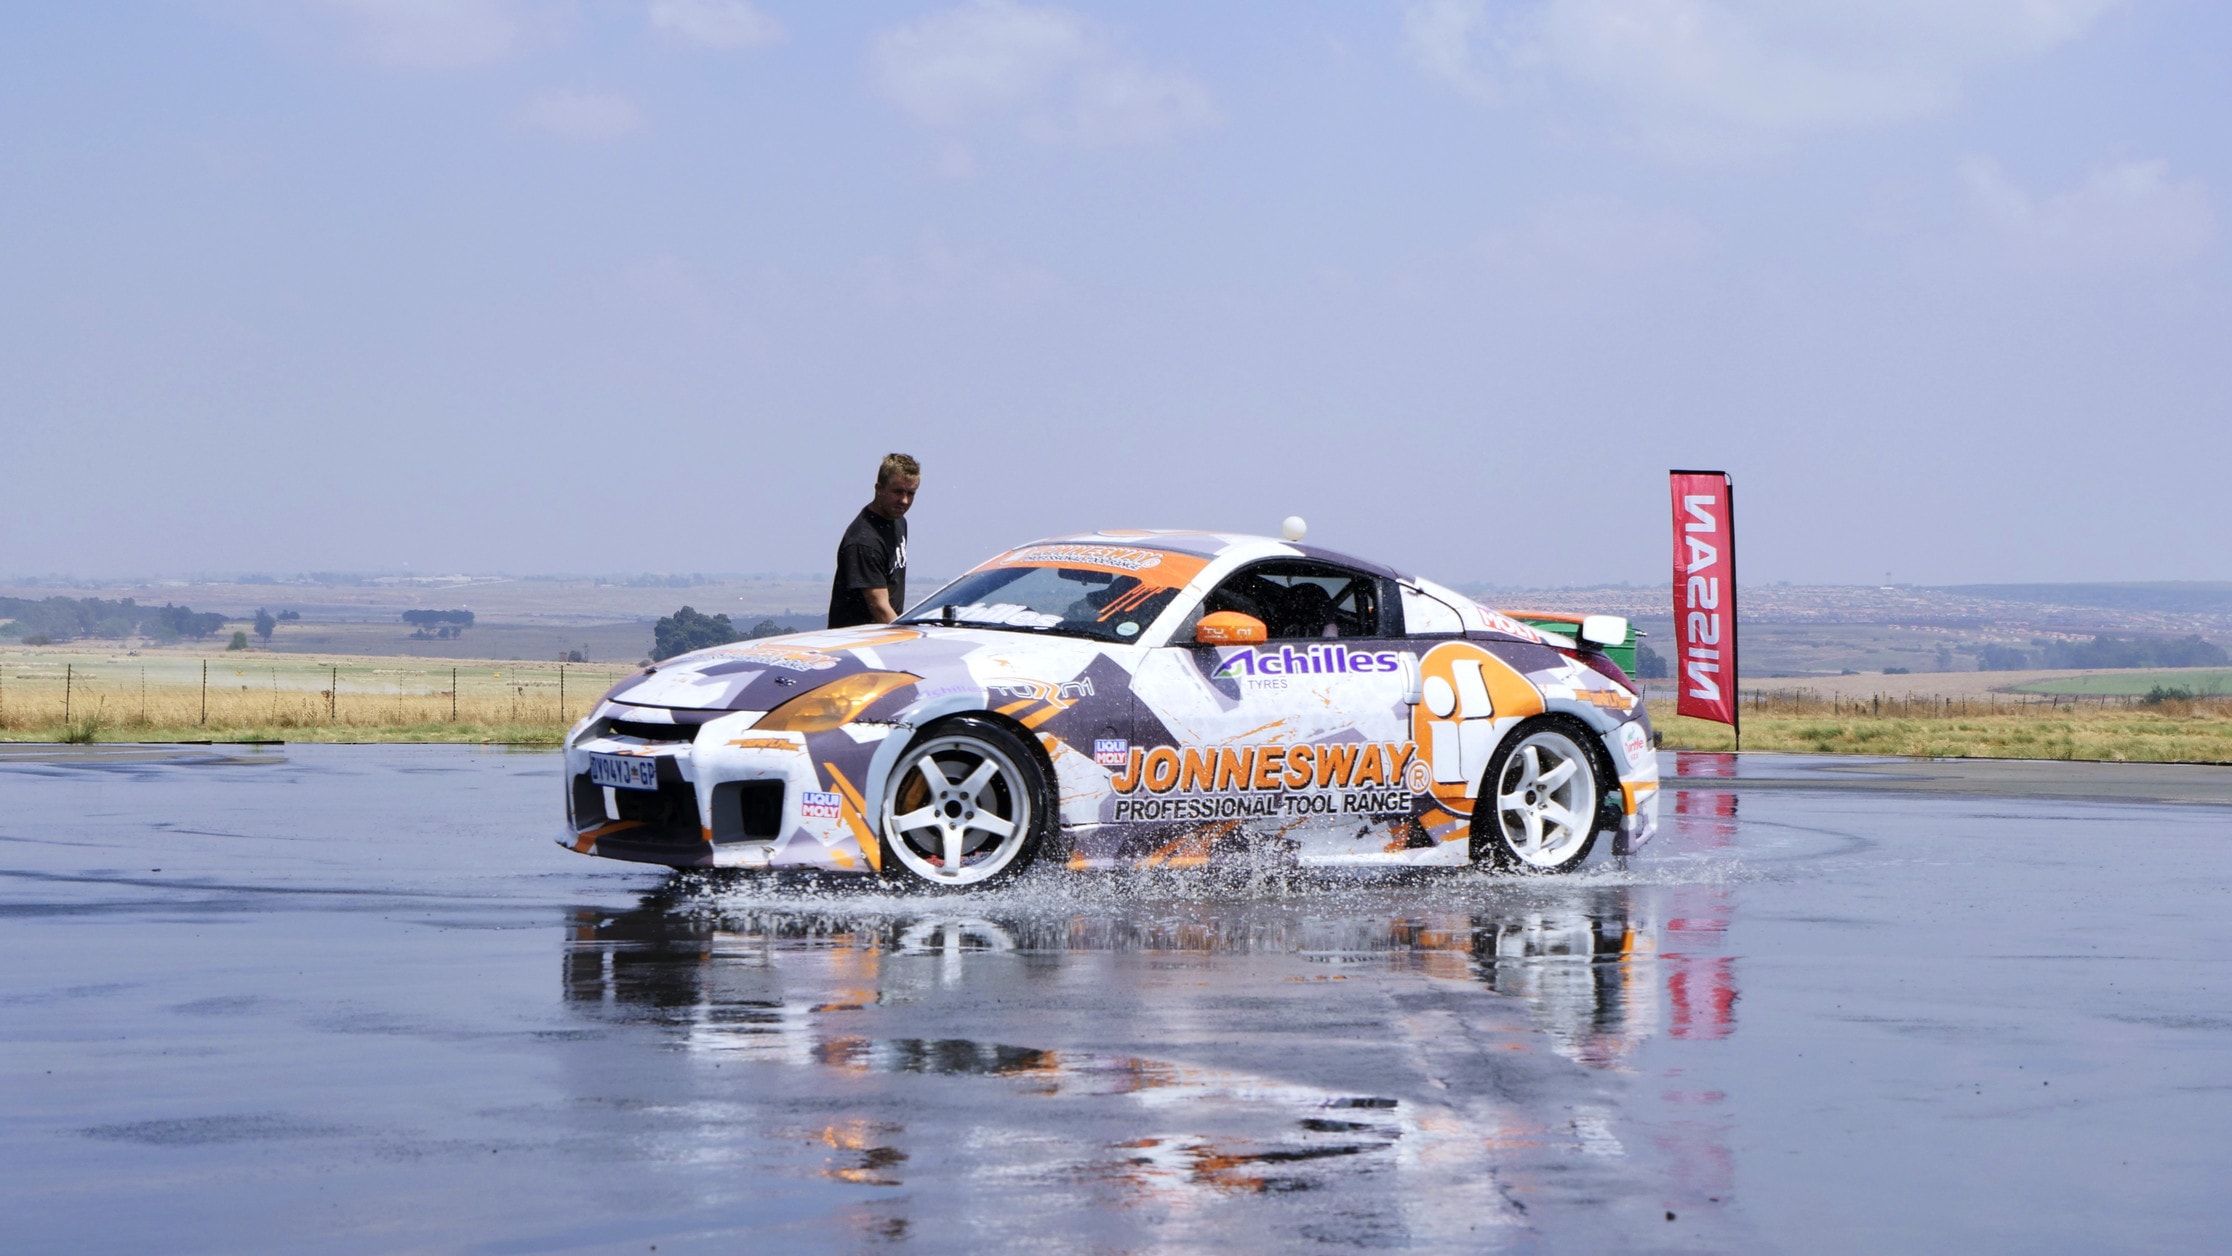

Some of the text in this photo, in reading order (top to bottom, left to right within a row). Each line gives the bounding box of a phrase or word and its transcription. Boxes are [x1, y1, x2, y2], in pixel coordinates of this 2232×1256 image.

[1213, 647, 1398, 676] Achilles
[1248, 679, 1288, 689] TYRES
[1097, 741, 1126, 752] LIQUI
[1098, 752, 1126, 763] MOLY
[639, 762, 655, 785] GP
[1111, 743, 1415, 794] JONNESWAY
[803, 793, 841, 805] LIQUI
[802, 805, 840, 818] MOLY
[1115, 792, 1411, 820] PROFESSIONAL TOOL RANGE
